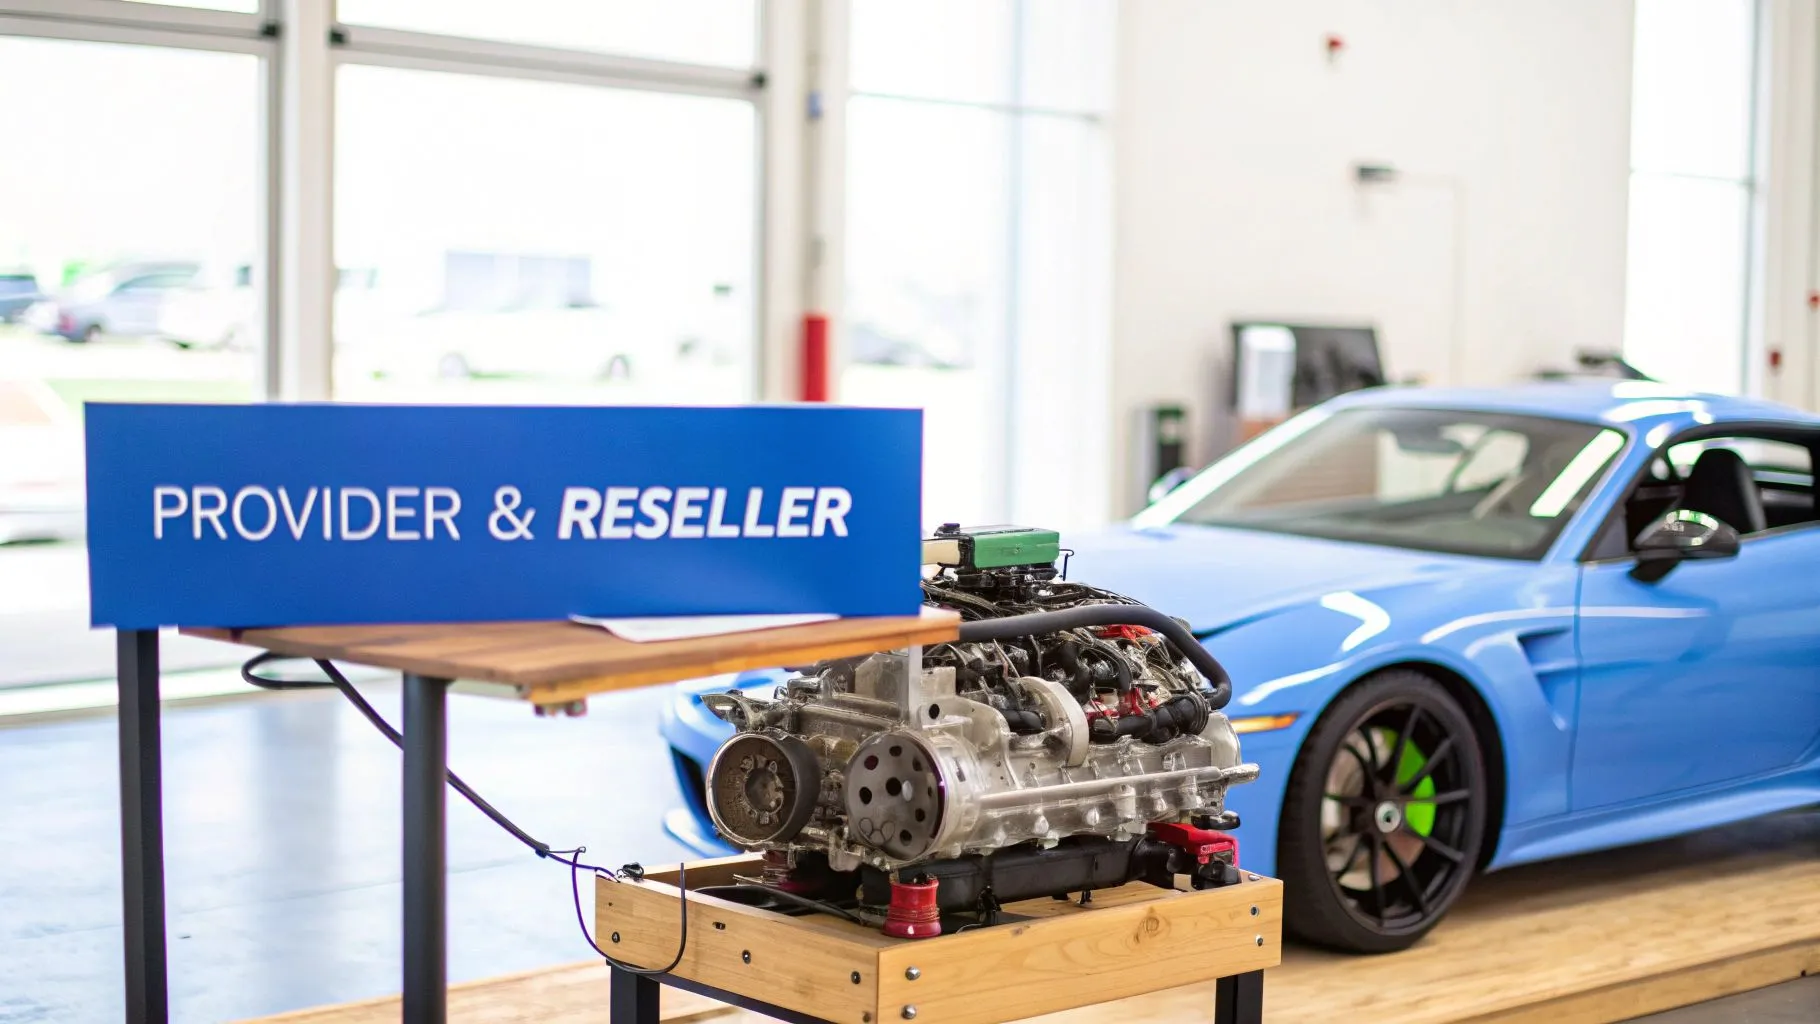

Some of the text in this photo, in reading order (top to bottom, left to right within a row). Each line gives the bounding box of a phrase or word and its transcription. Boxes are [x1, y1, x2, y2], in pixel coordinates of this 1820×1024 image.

[153, 485, 853, 541] PROVIDER & RESELLER
